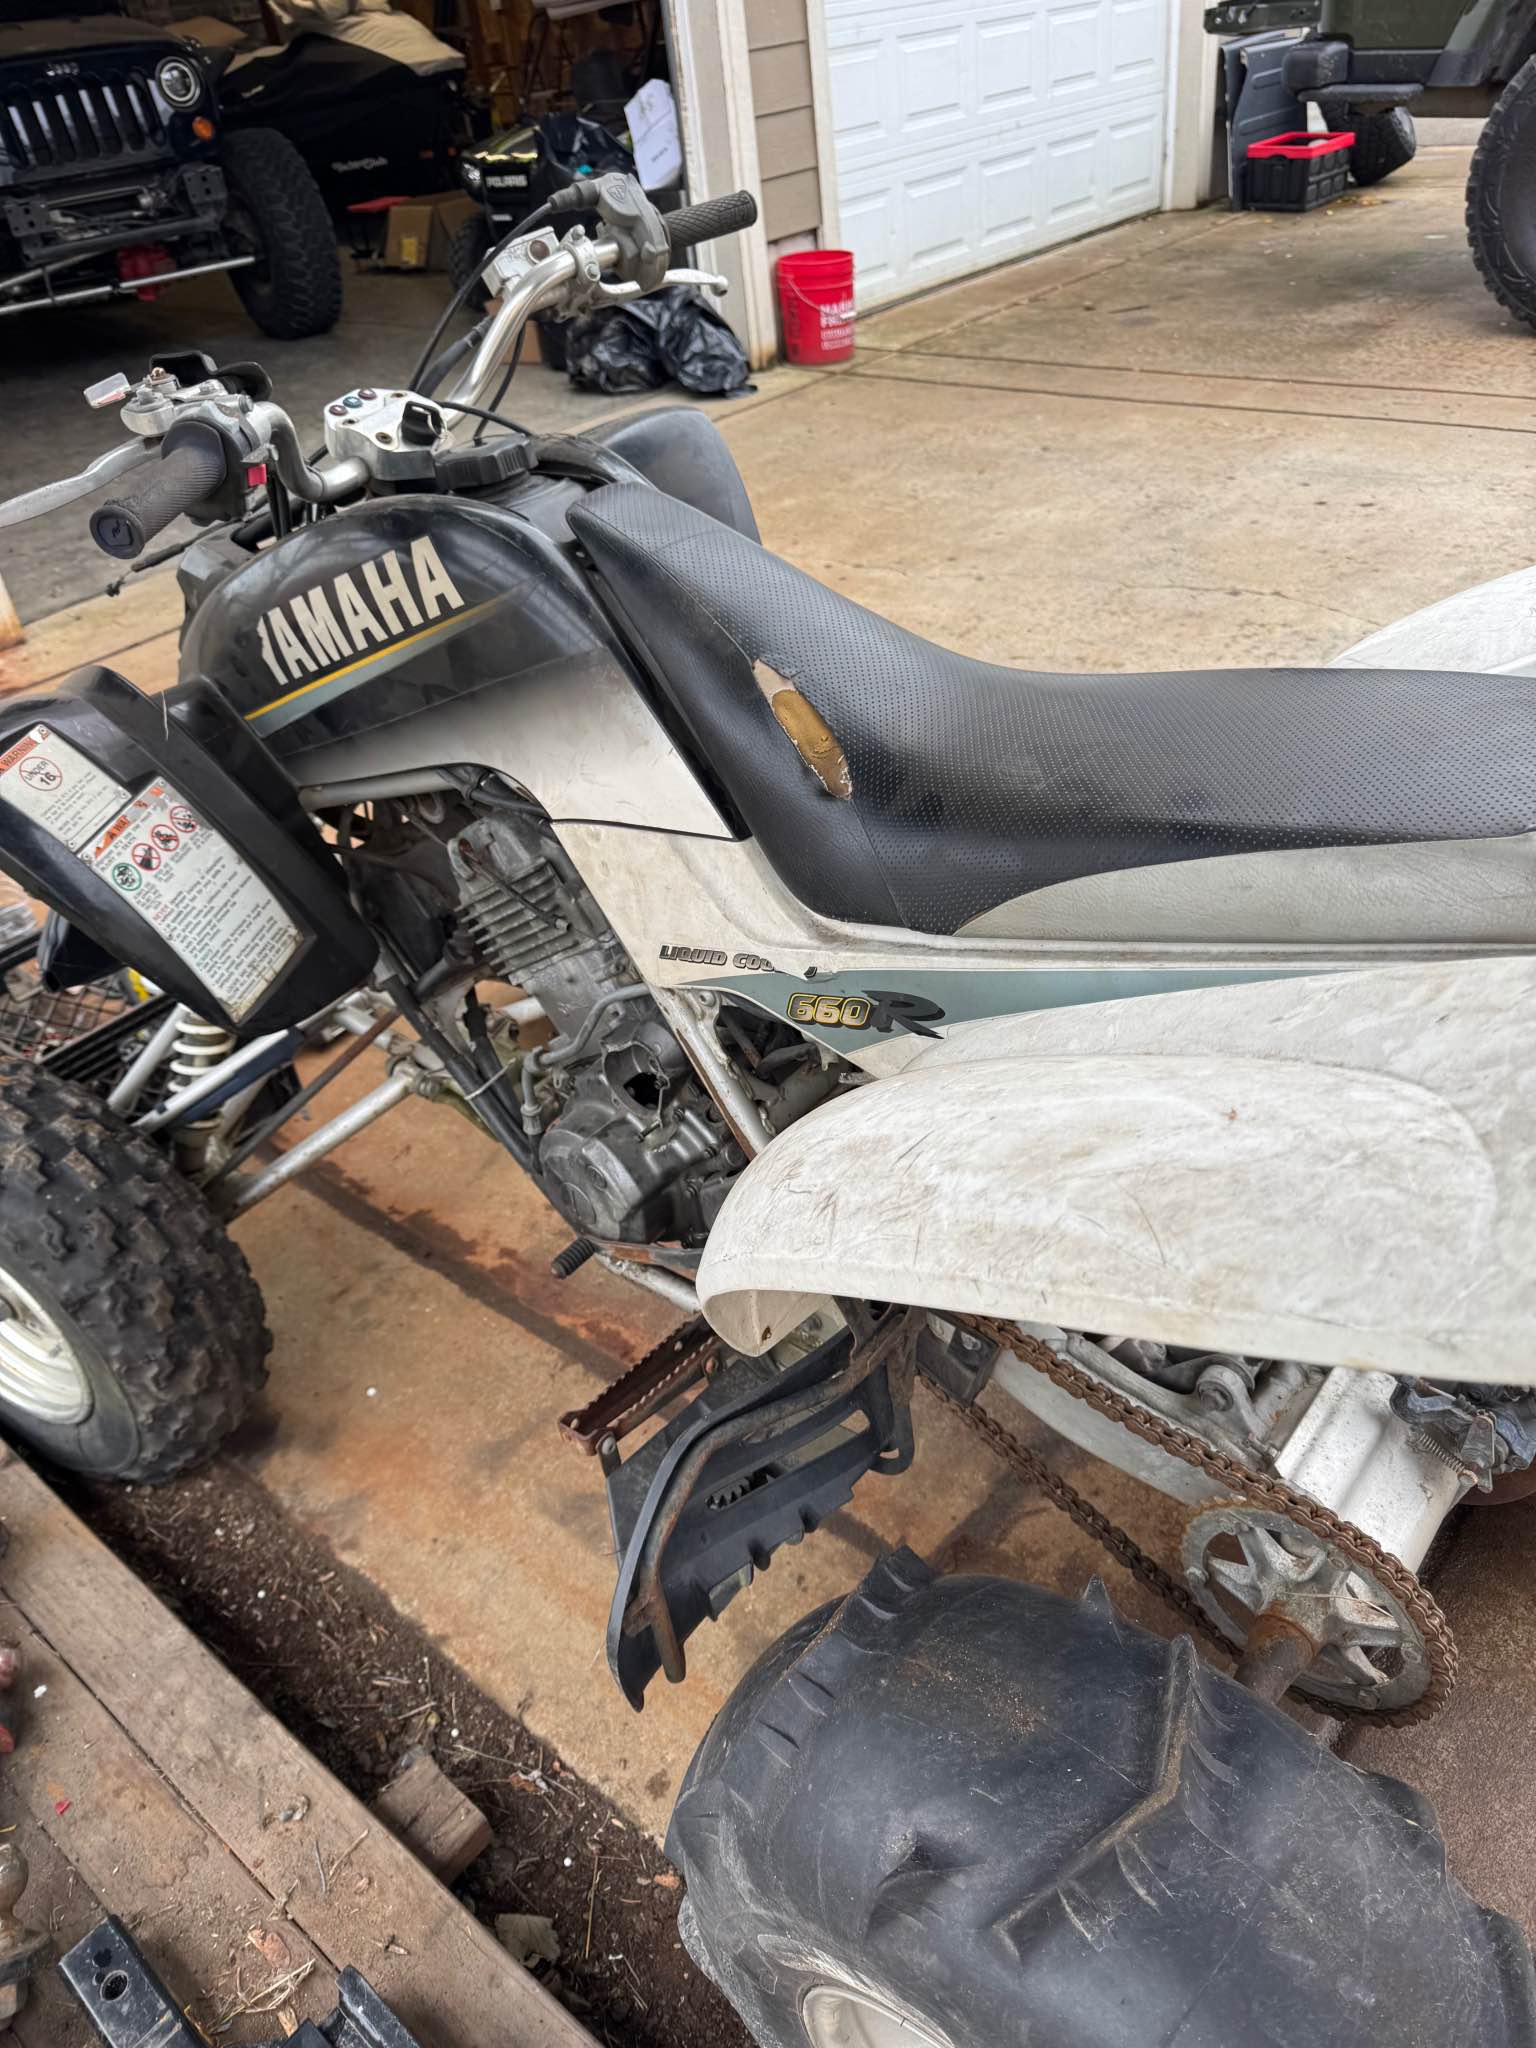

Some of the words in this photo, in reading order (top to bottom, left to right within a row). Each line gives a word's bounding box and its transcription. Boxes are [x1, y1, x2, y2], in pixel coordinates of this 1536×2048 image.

[24, 761, 49, 781] UNDER
[40, 771, 56, 785] 16
[659, 944, 727, 965] LIQUID
